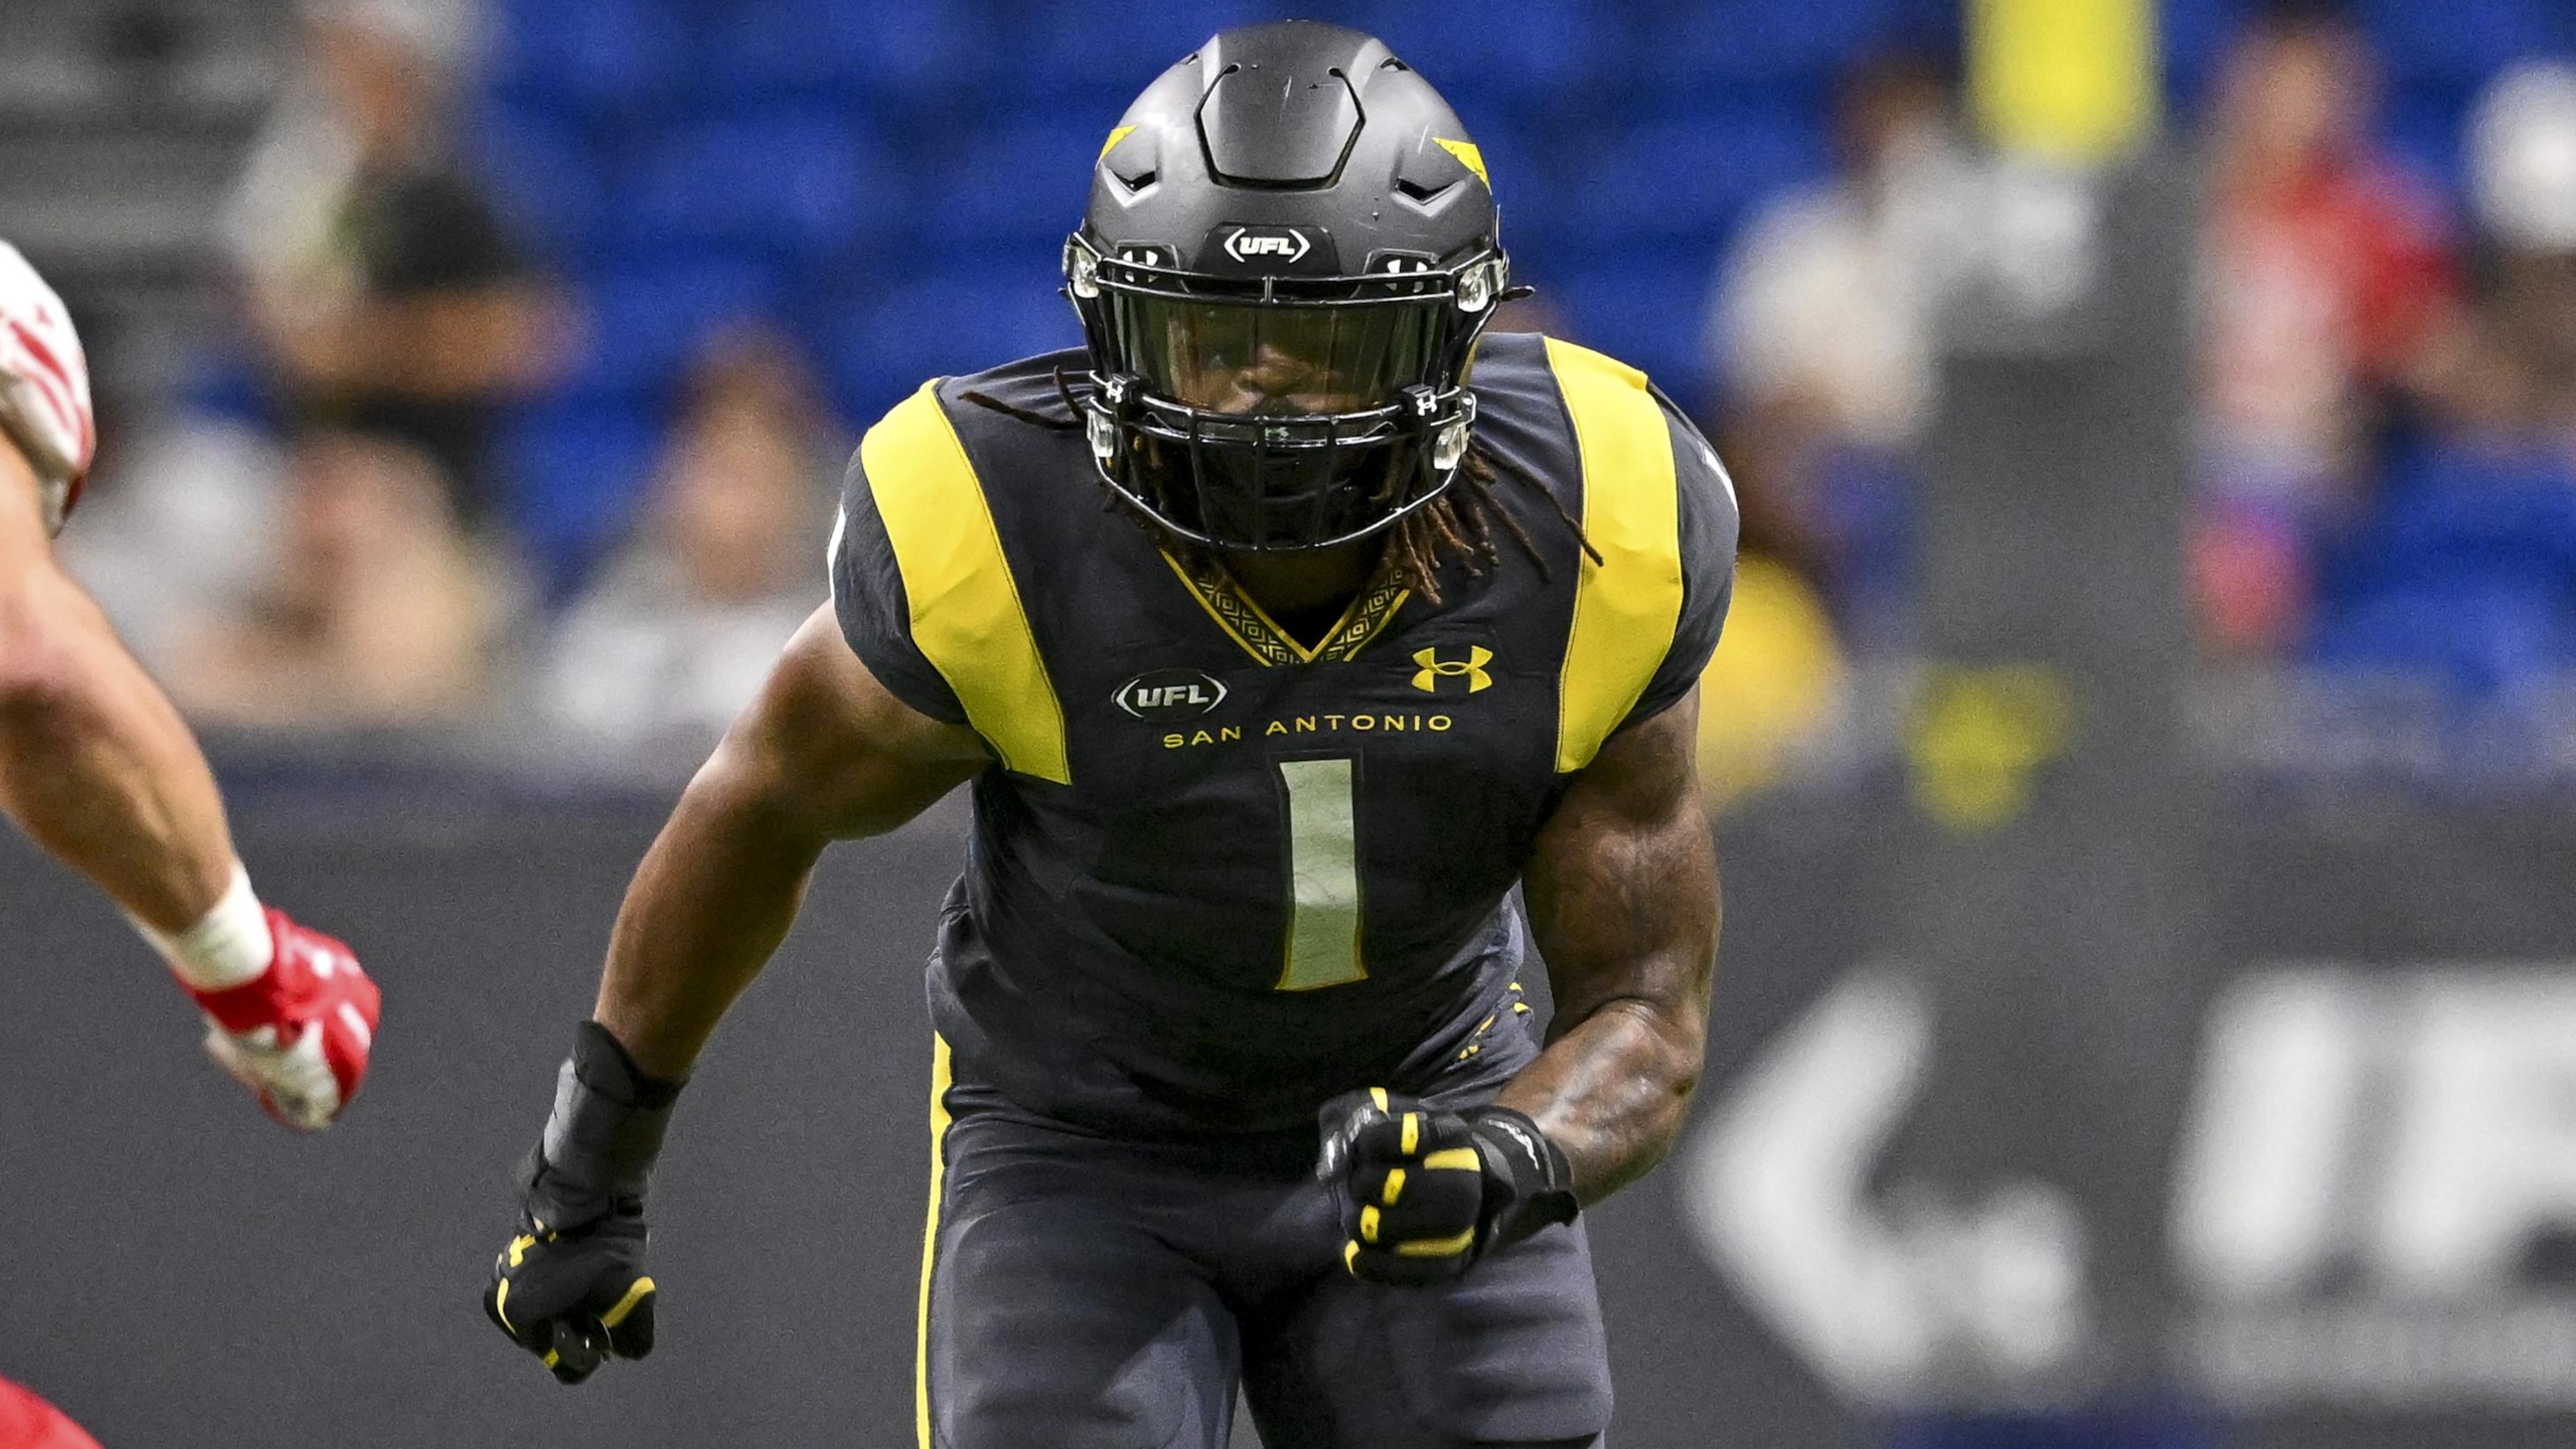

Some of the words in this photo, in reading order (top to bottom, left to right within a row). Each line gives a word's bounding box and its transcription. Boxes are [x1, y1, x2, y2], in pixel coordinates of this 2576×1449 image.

[1239, 237, 1295, 254] UFL
[1137, 684, 1210, 708] UFL
[1163, 725, 1241, 749] SAN
[1266, 714, 1452, 736] ANTONIO
[1275, 759, 1368, 991] 1
